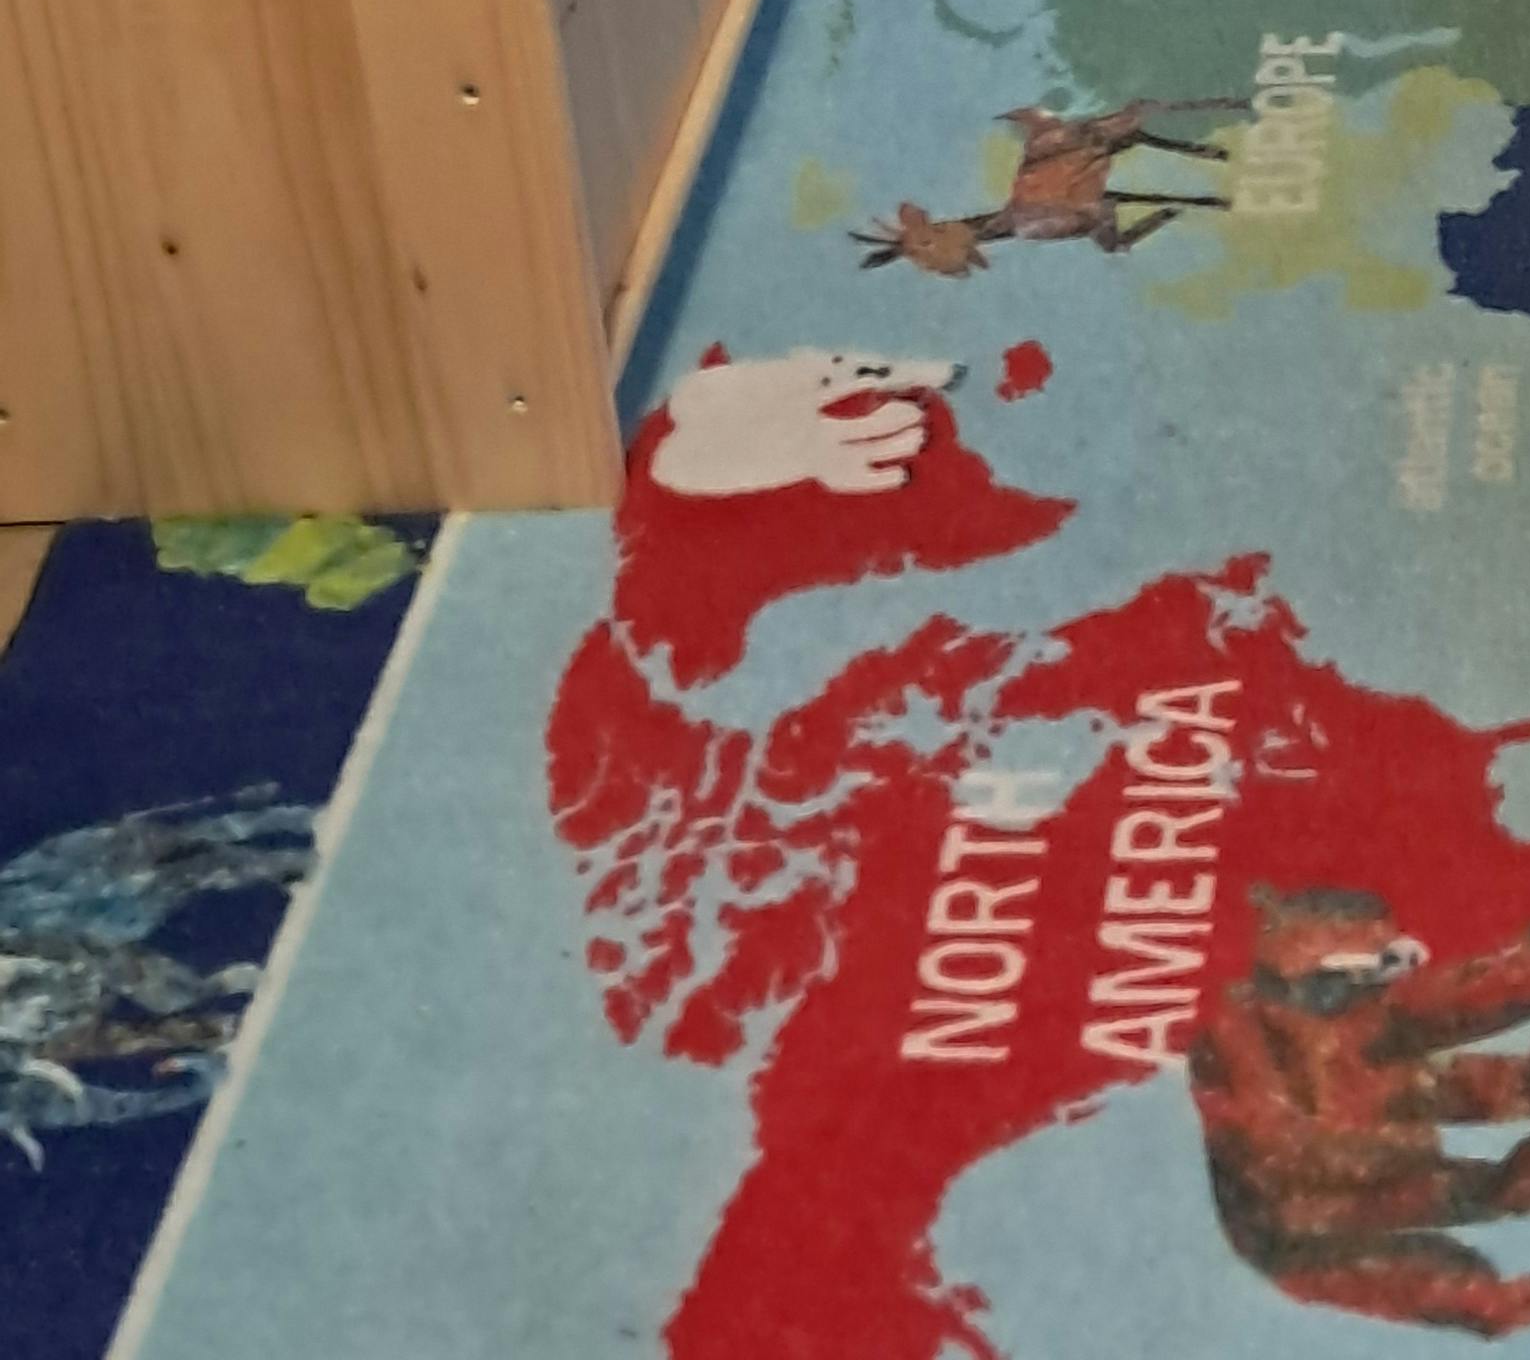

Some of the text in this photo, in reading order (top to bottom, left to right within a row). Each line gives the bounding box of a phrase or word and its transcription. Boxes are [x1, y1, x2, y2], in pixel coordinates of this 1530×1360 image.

[1235, 31, 1344, 214] EUROPE
[900, 766, 1055, 1063] NORTH
[1081, 679, 1242, 1070] AMERICA
